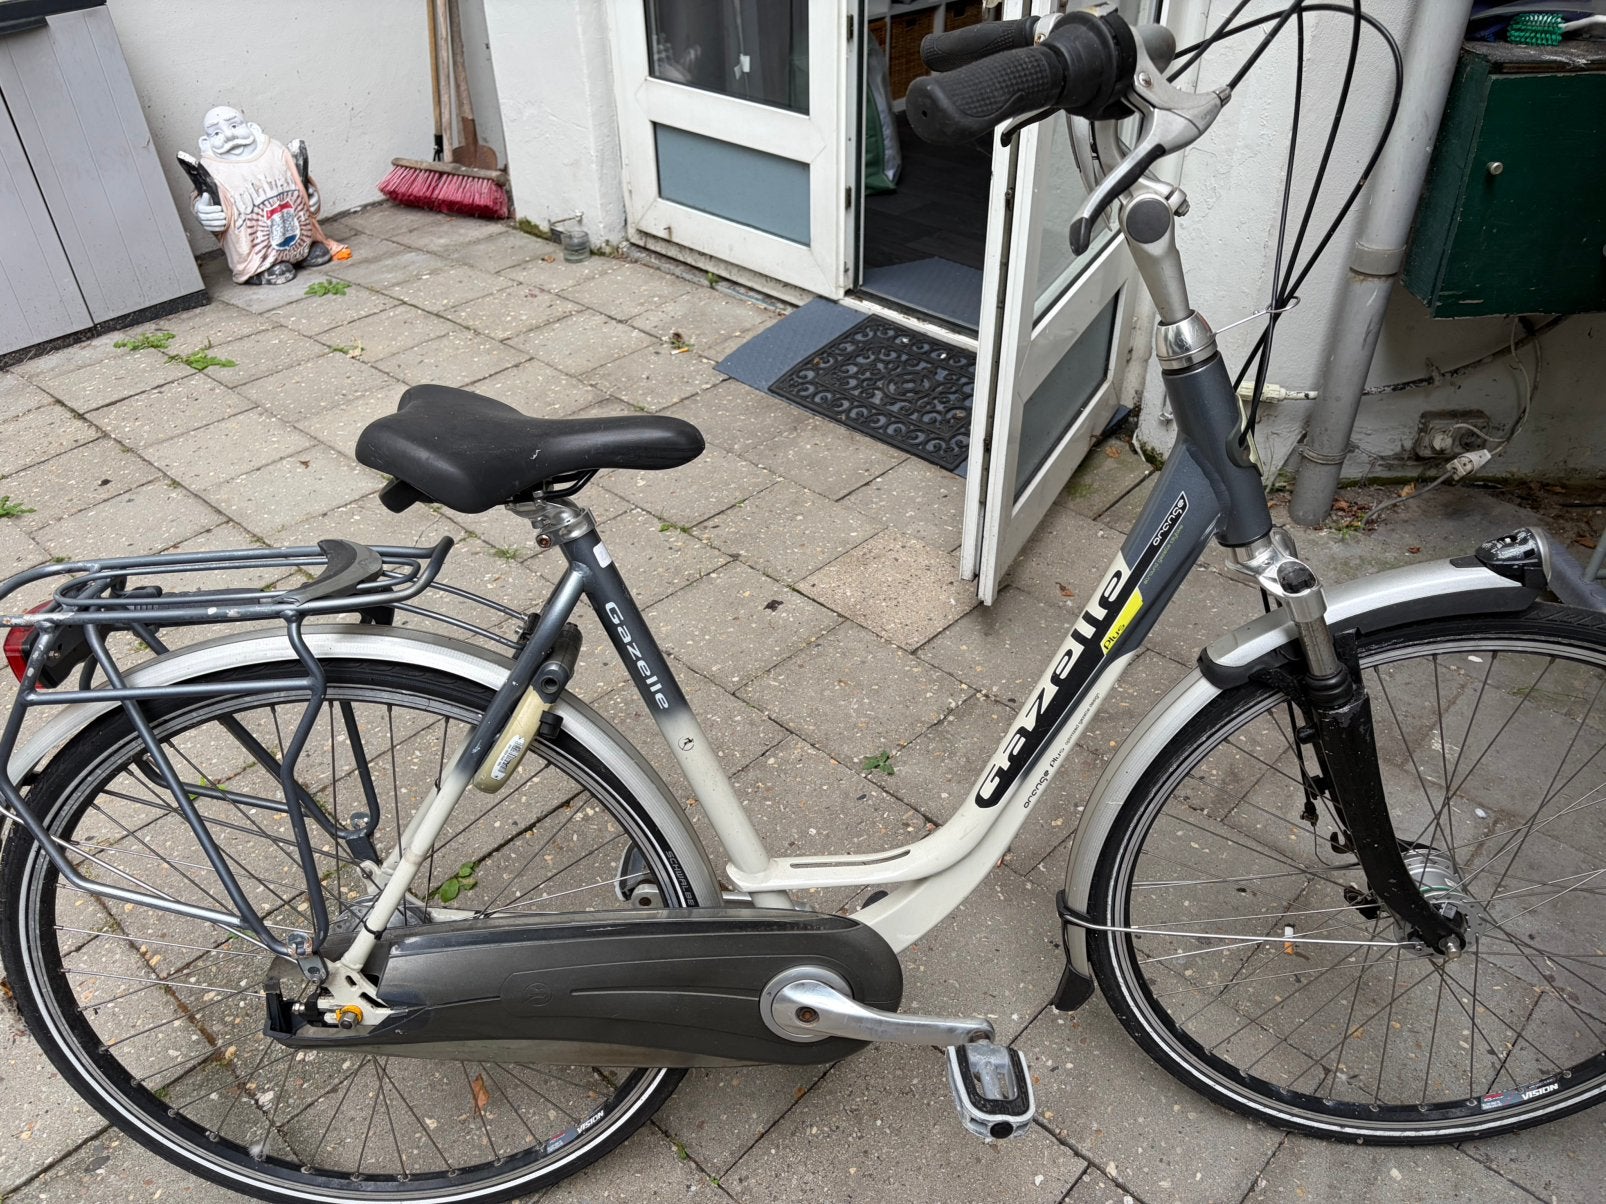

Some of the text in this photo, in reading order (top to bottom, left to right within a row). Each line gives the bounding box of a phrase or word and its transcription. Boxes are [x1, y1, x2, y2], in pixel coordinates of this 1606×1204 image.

[605, 601, 669, 709] Gazelle
[974, 569, 1123, 809] Gazelle
[666, 850, 695, 906] SCHWALBE
[1521, 1083, 1559, 1101] VISION
[576, 1109, 604, 1134] VISION
